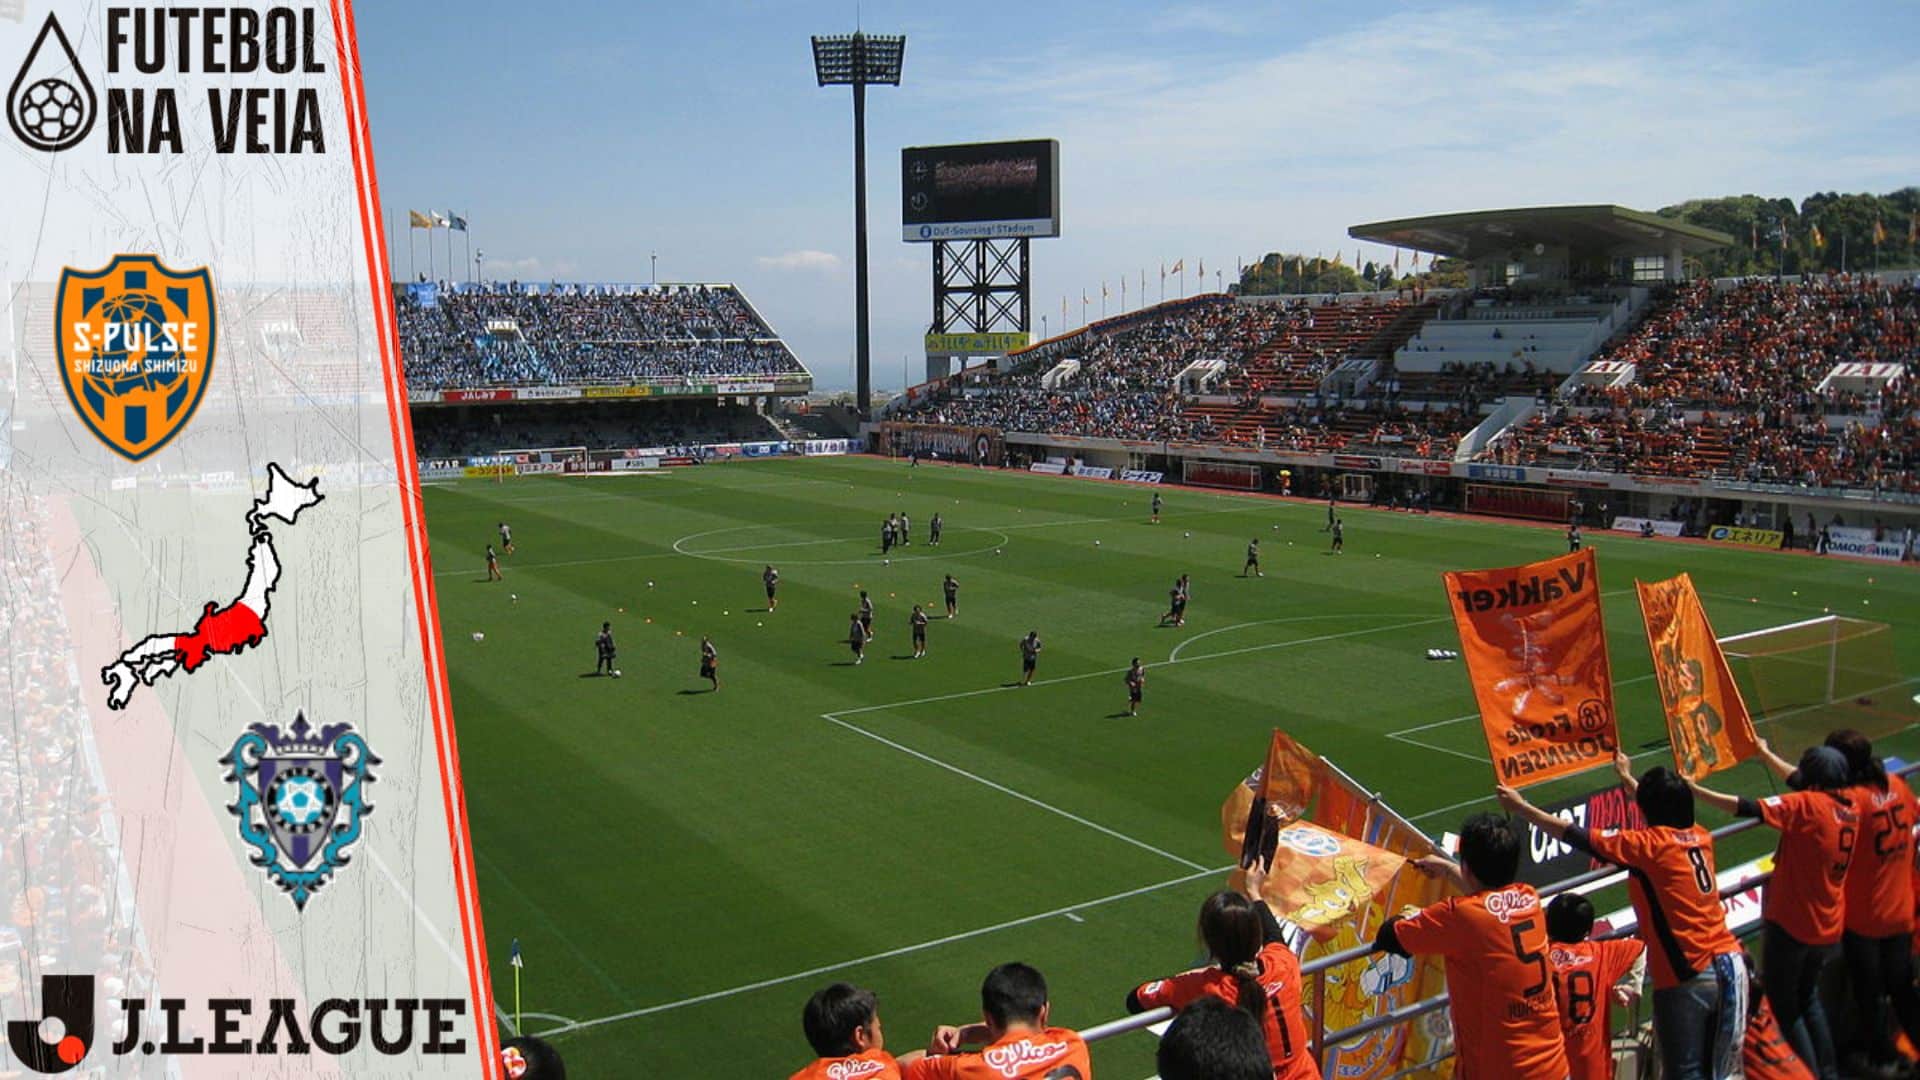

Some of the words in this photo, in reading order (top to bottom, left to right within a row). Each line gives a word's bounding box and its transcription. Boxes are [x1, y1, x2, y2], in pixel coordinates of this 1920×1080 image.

[1687, 846, 1713, 894] 8
[1510, 919, 1547, 998] 5
[988, 1040, 1067, 1077] Glico
